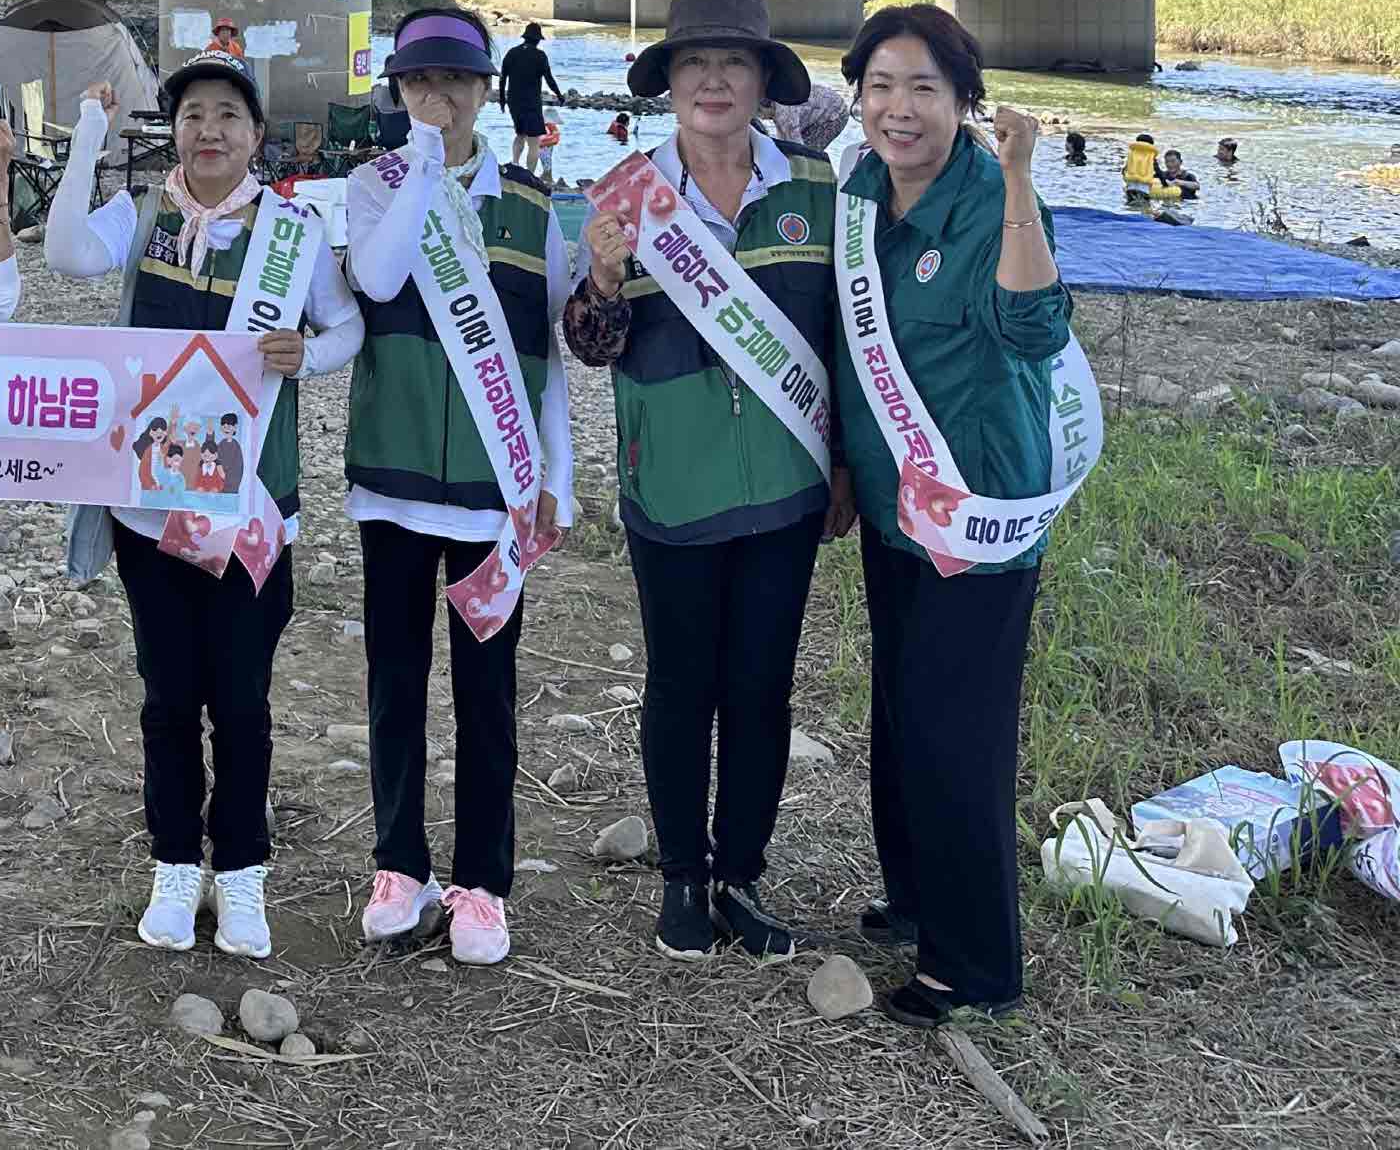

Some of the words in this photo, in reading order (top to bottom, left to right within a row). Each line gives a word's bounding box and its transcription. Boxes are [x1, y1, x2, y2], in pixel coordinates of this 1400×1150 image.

[652, 222, 730, 308] 밀양시
[7, 374, 99, 429] 하남읍
[473, 352, 536, 495] 전입오세요
